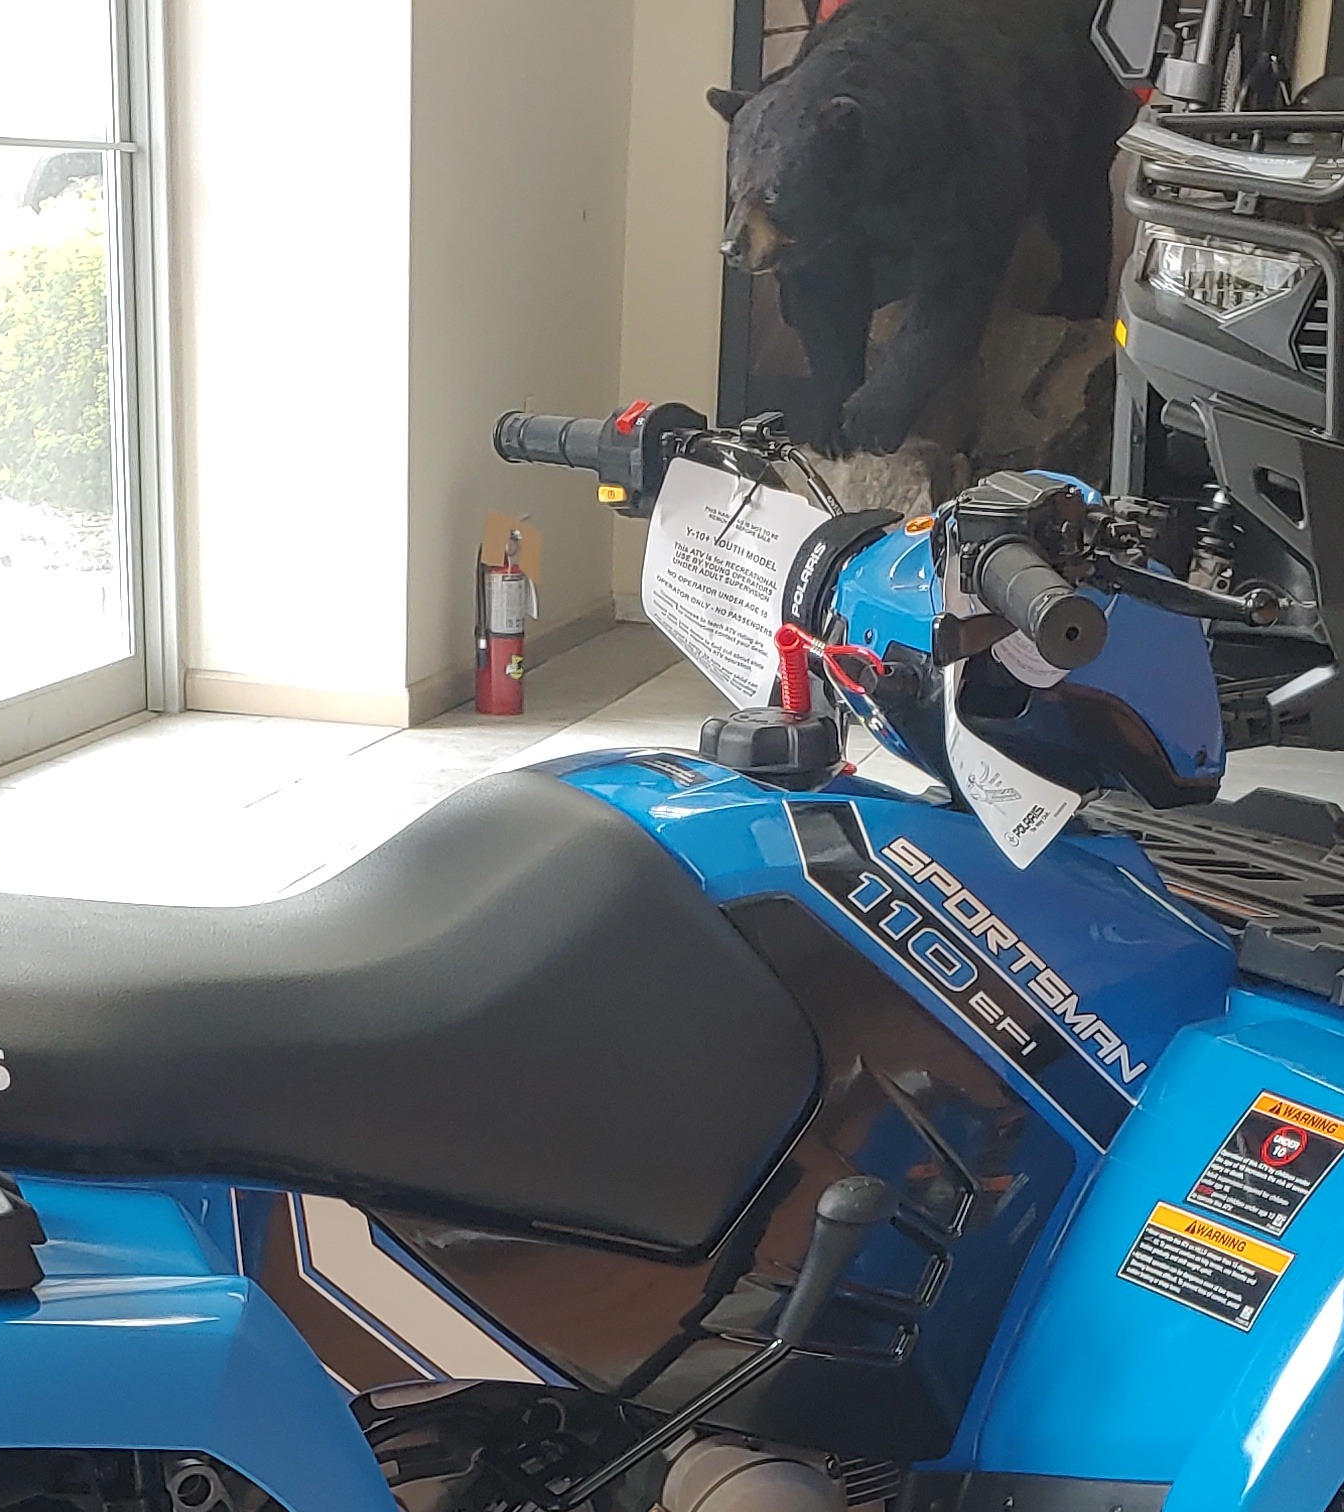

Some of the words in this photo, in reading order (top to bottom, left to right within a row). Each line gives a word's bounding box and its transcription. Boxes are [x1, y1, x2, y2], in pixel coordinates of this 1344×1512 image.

[674, 541, 688, 553] This
[690, 548, 706, 559] ATV
[725, 560, 778, 590] RECREATIONAL
[686, 527, 710, 542] Y-10+
[713, 535, 745, 557] YOUTH
[746, 552, 777, 572] MODEL
[667, 568, 677, 579] NO
[677, 574, 717, 596] OPERATOR
[718, 589, 744, 606] UNDER
[744, 602, 760, 613] AGE
[672, 557, 697, 574] UNDER
[698, 568, 724, 582] ADULT
[725, 576, 770, 603] SUPERVISION
[675, 551, 690, 562] USE
[690, 556, 703, 566] BY
[703, 561, 731, 577] YOUNG
[732, 571, 773, 596] OPERATORS
[791, 541, 827, 618] POLARIS
[656, 574, 690, 600] OPERATOR
[690, 597, 710, 611] ONLY
[715, 606, 727, 617] NO
[727, 611, 773, 638] PASSENGERS
[1013, 804, 1047, 838] POLARIS
[847, 872, 978, 992] 110
[968, 991, 1038, 1056] EFI
[881, 836, 1148, 1084] SPORTSMAN
[1272, 1134, 1300, 1150] UNDER
[1281, 1105, 1339, 1135] WARNING
[1272, 1145, 1288, 1158] 10
[1195, 1223, 1247, 1253] WARNING
